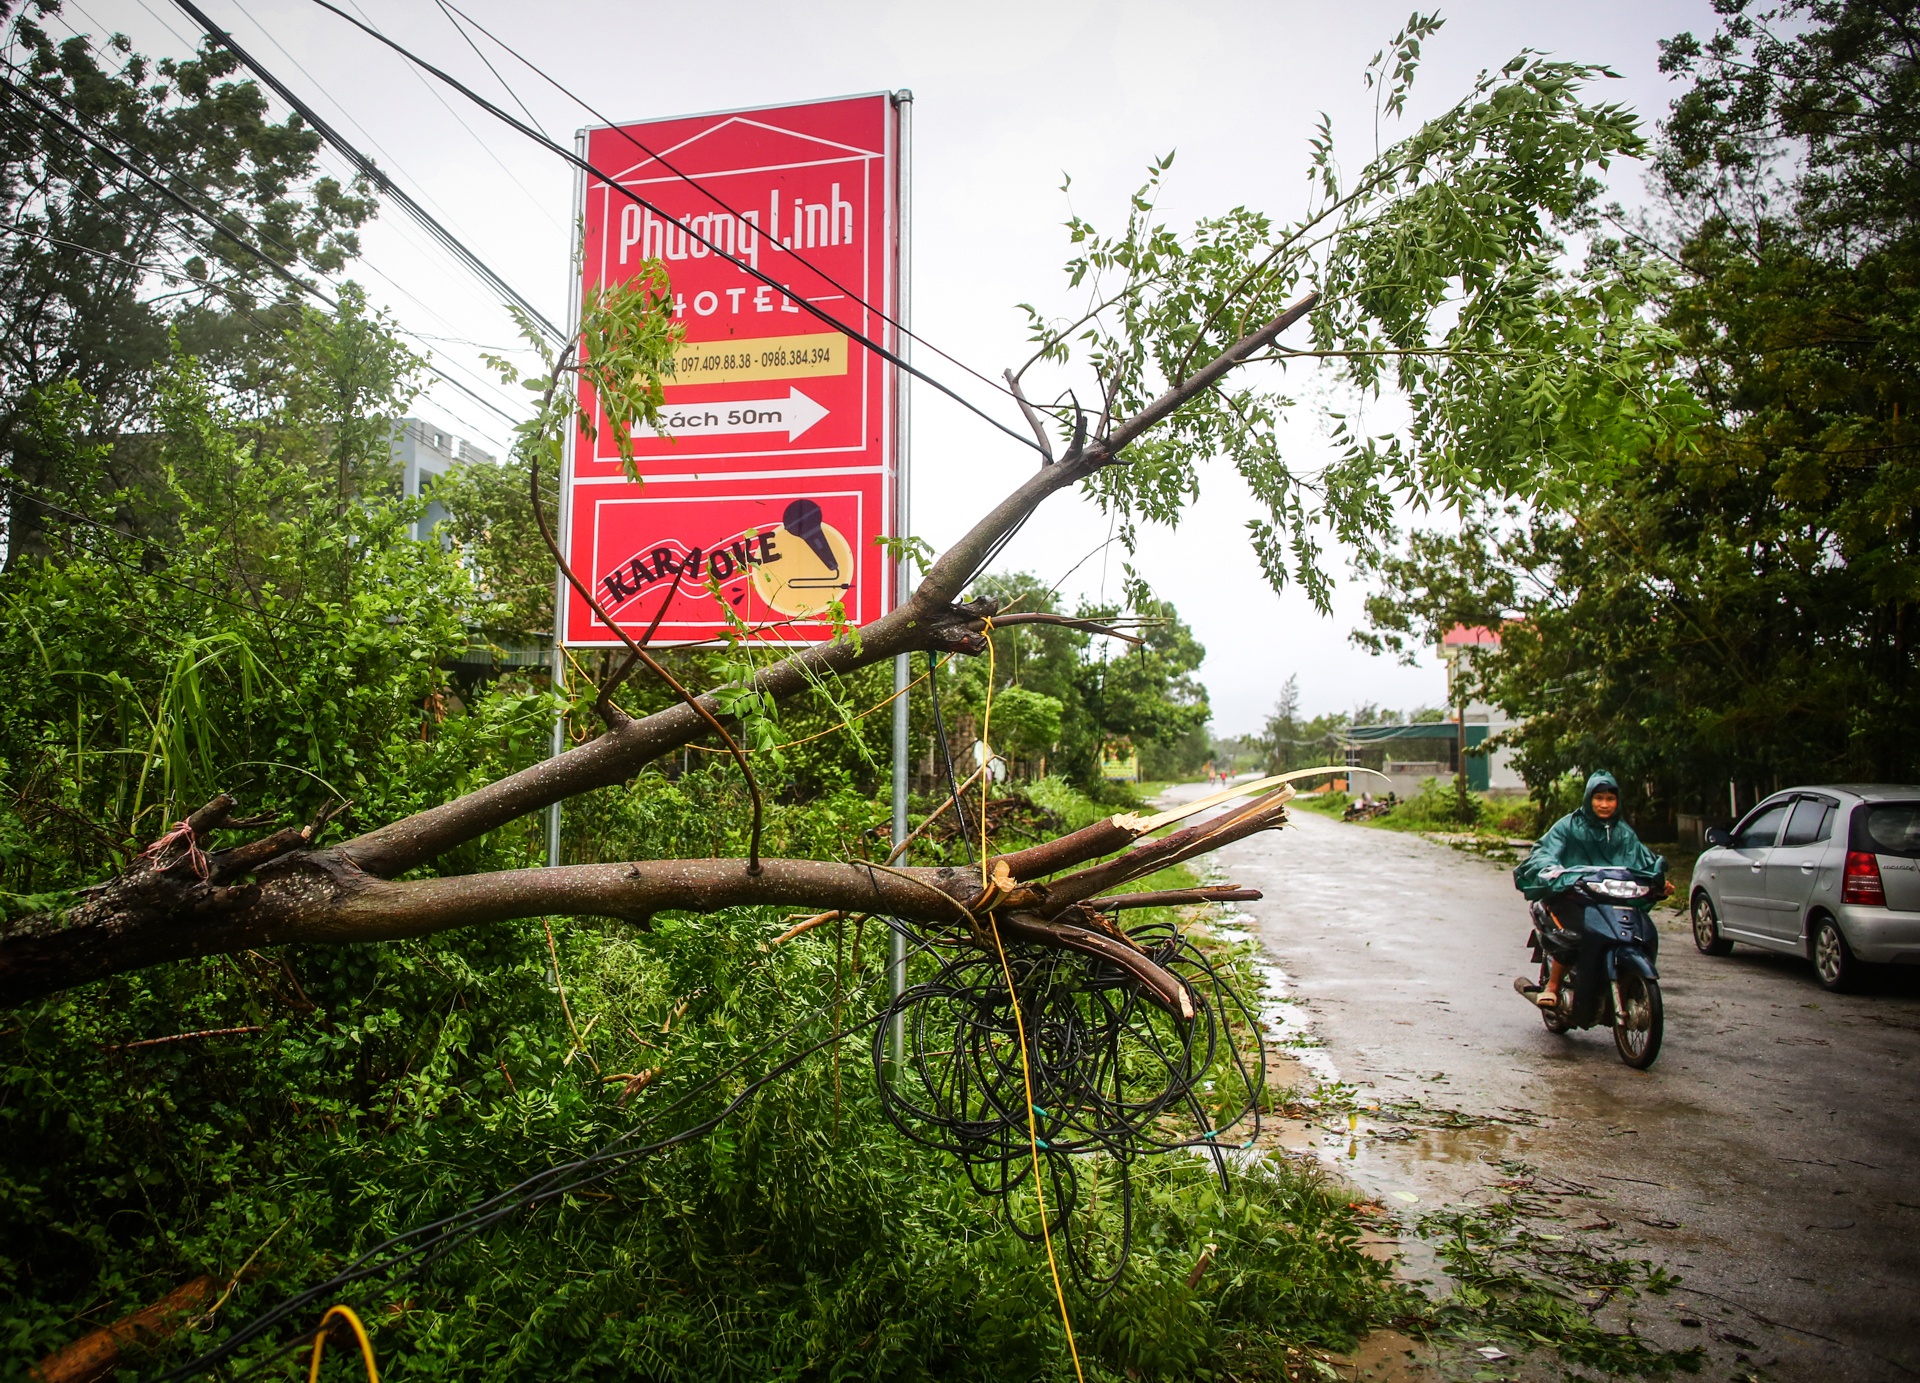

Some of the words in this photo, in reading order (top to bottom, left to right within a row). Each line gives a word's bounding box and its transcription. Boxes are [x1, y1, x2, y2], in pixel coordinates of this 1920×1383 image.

[619, 202, 759, 274] Phương
[770, 182, 853, 252] Linh
[681, 353, 751, 372] 097.409.88.38
[761, 348, 830, 367] 0988.384.394
[727, 409, 782, 426] 50m
[603, 531, 782, 604] KARAOKE
